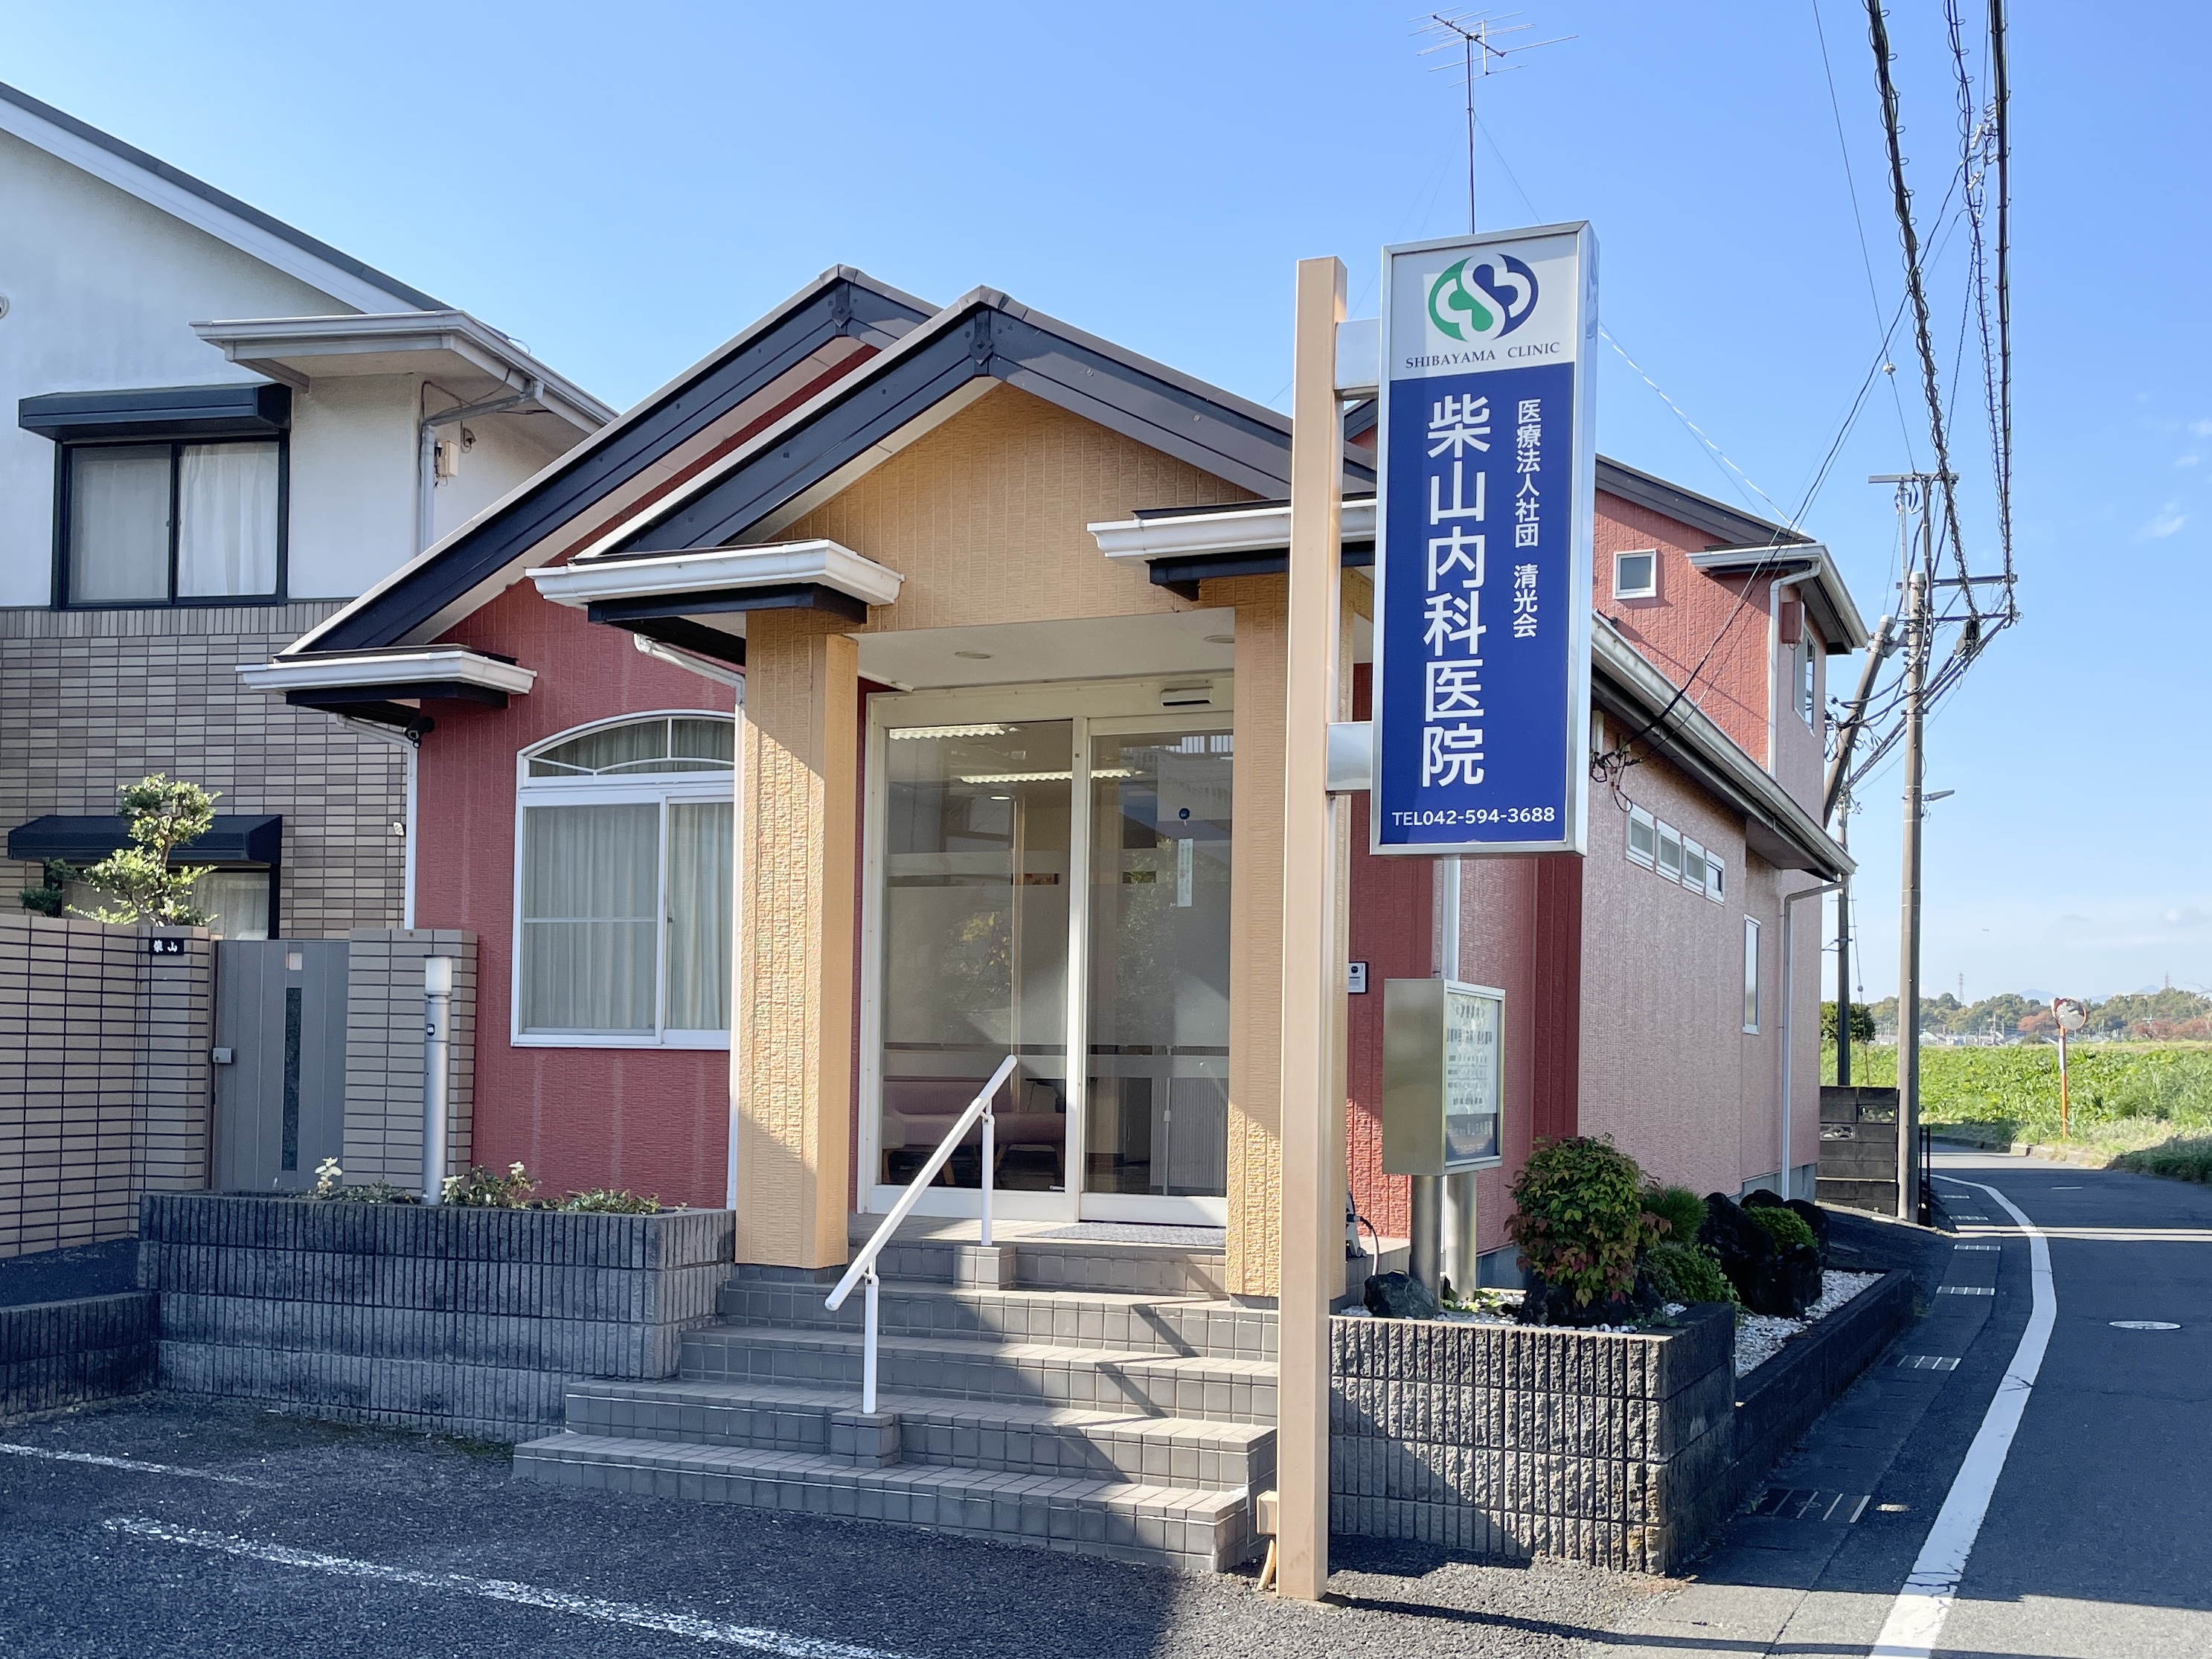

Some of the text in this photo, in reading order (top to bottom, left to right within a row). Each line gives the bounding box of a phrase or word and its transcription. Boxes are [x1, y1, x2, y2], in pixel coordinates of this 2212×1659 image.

[1405, 341, 1560, 369] SHIBAYAMA CLINIC
[1513, 398, 1542, 638] 医療法人社団 清光会
[1422, 393, 1491, 788] 柴山内科医院
[1391, 806, 1556, 827] TEL042-594-3688
